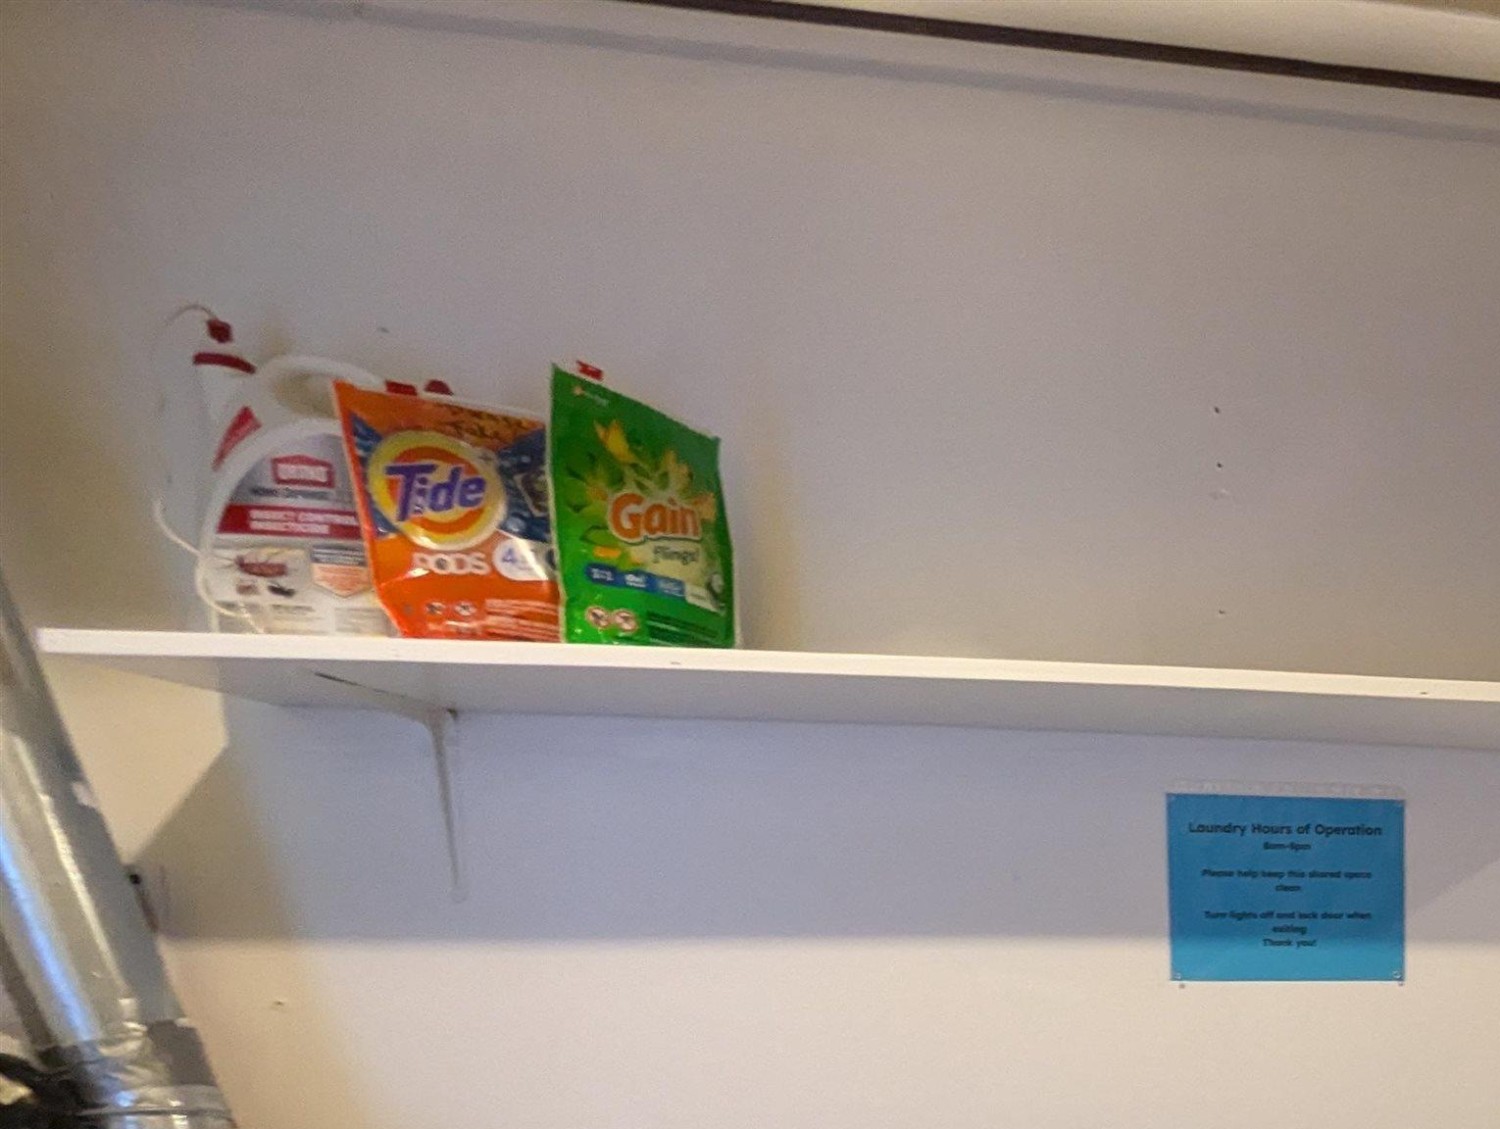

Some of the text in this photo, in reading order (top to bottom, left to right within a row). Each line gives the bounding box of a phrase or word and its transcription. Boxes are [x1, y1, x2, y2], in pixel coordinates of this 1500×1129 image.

[385, 462, 488, 522] Tide
[609, 492, 702, 542] Gain
[412, 551, 493, 576] PODS
[1188, 822, 1383, 837] Laundry Hours of Operation
[1202, 869, 1235, 877] Please
[1237, 869, 1259, 878] help
[1262, 869, 1285, 879] keep
[1308, 870, 1342, 878] shared
[1344, 871, 1372, 879] space
[1275, 883, 1301, 892] clean
[1204, 910, 1372, 920] Turn lights off and lock door when
[1263, 938, 1292, 946] Thank
